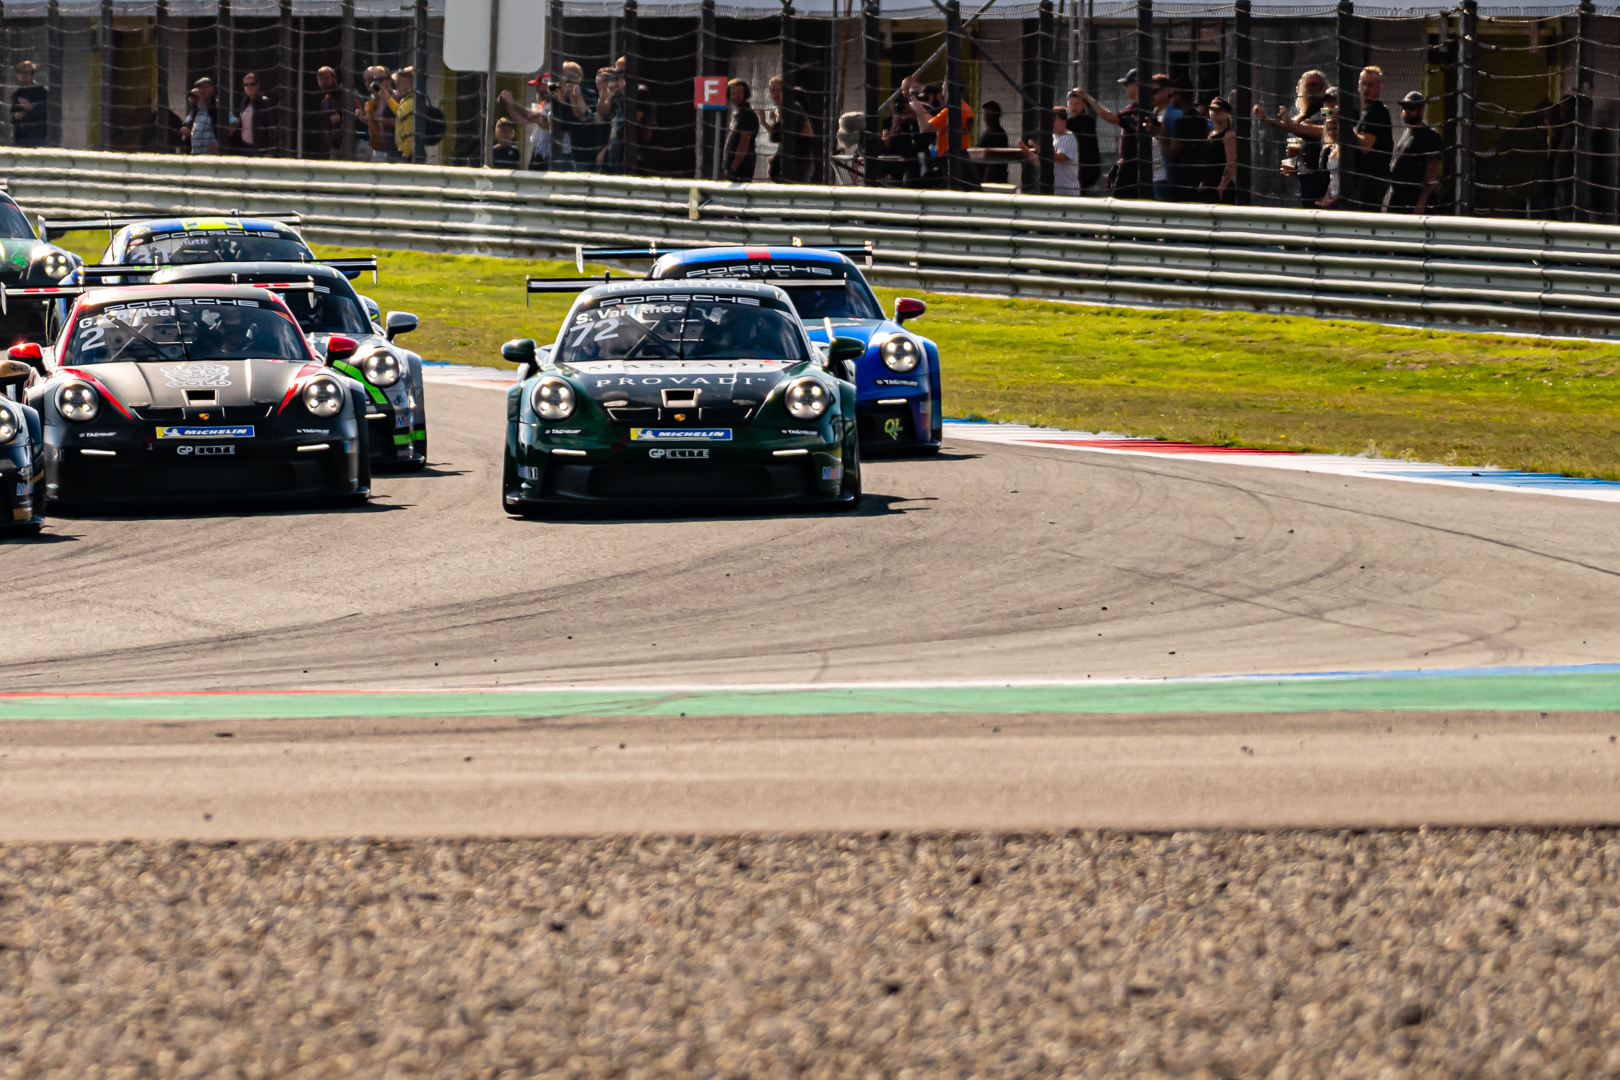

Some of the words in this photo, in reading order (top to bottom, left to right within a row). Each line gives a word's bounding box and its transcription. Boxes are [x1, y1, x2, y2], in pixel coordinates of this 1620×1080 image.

[704, 79, 719, 102] F
[152, 230, 280, 242] PORSCHE
[685, 264, 833, 278] PORSCHE
[104, 298, 260, 313] PORSCHE
[599, 294, 760, 308] PORSCHE
[576, 312, 593, 324] S.
[597, 307, 630, 320] Van
[80, 327, 106, 352] 2
[570, 319, 620, 348] 72
